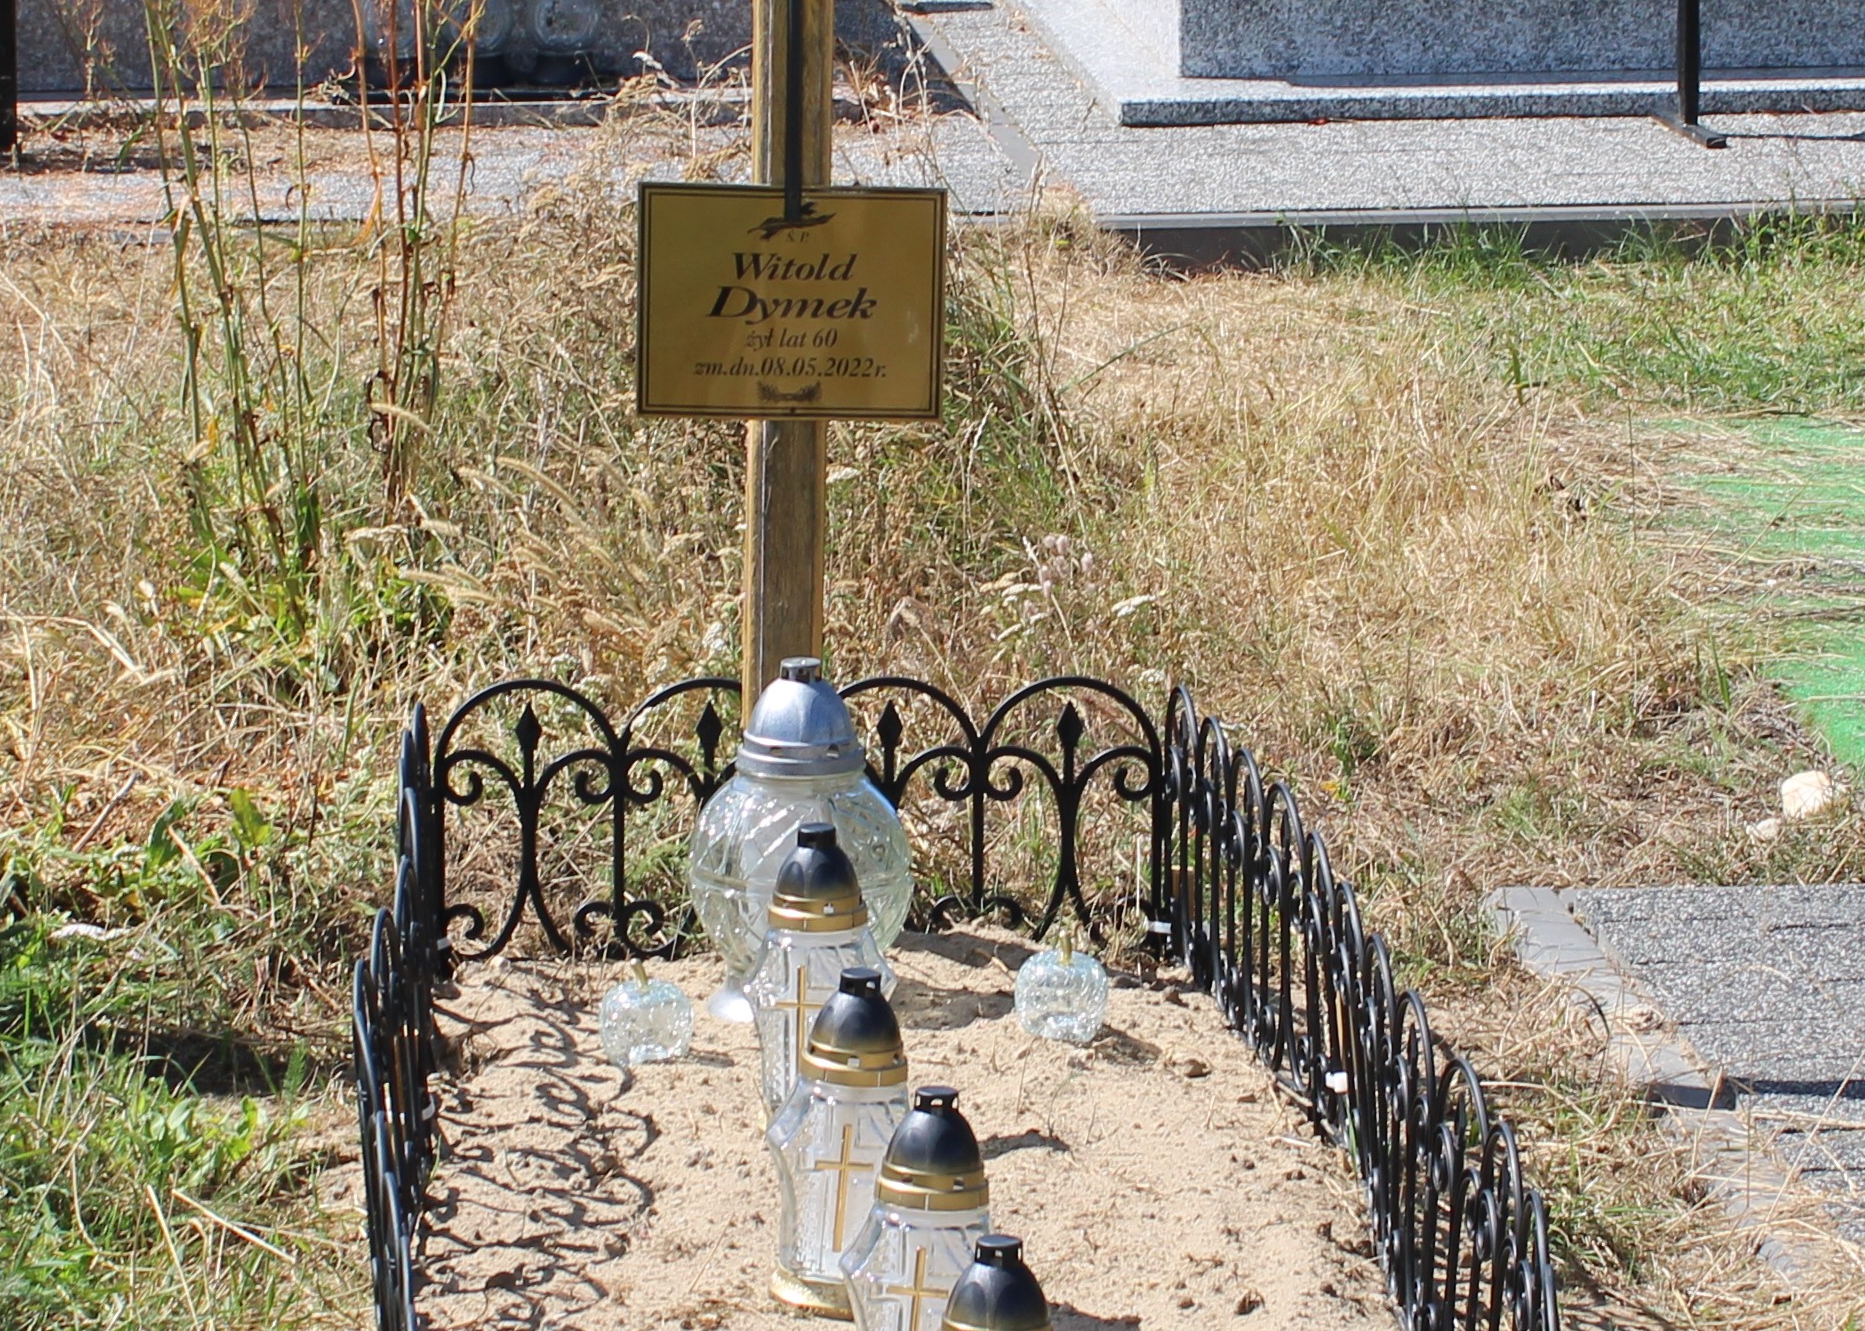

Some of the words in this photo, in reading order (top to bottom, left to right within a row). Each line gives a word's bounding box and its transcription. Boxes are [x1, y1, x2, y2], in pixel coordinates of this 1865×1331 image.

[733, 252, 858, 281] Witold
[707, 286, 878, 325] Dymek
[779, 328, 807, 348] lat
[812, 328, 839, 348] 60
